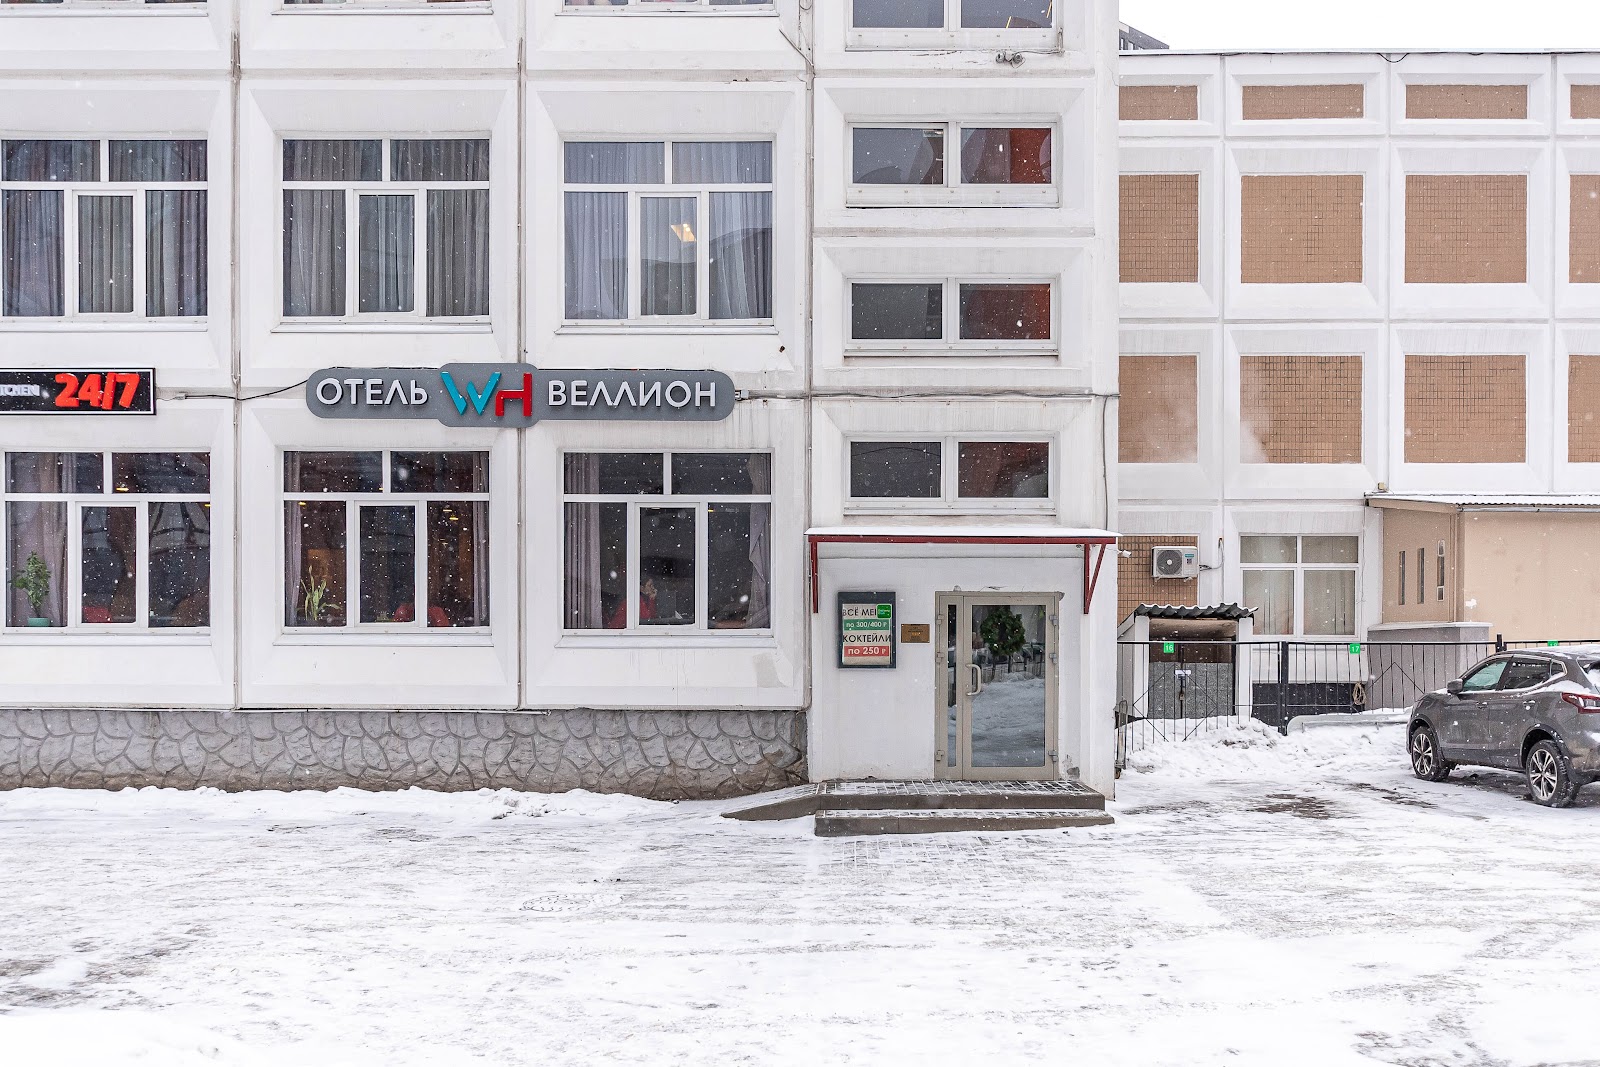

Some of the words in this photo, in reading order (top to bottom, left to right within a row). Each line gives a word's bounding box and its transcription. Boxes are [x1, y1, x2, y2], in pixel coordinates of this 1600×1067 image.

[55, 372, 140, 410] 24/7
[316, 377, 429, 406] ОТЕЛЬ
[440, 371, 533, 417] WH
[548, 380, 716, 408] ВЕЛЛИОН
[842, 633, 891, 643] КОКТЕЙЛИ
[862, 646, 880, 655] 250
[1351, 645, 1360, 653] 17
